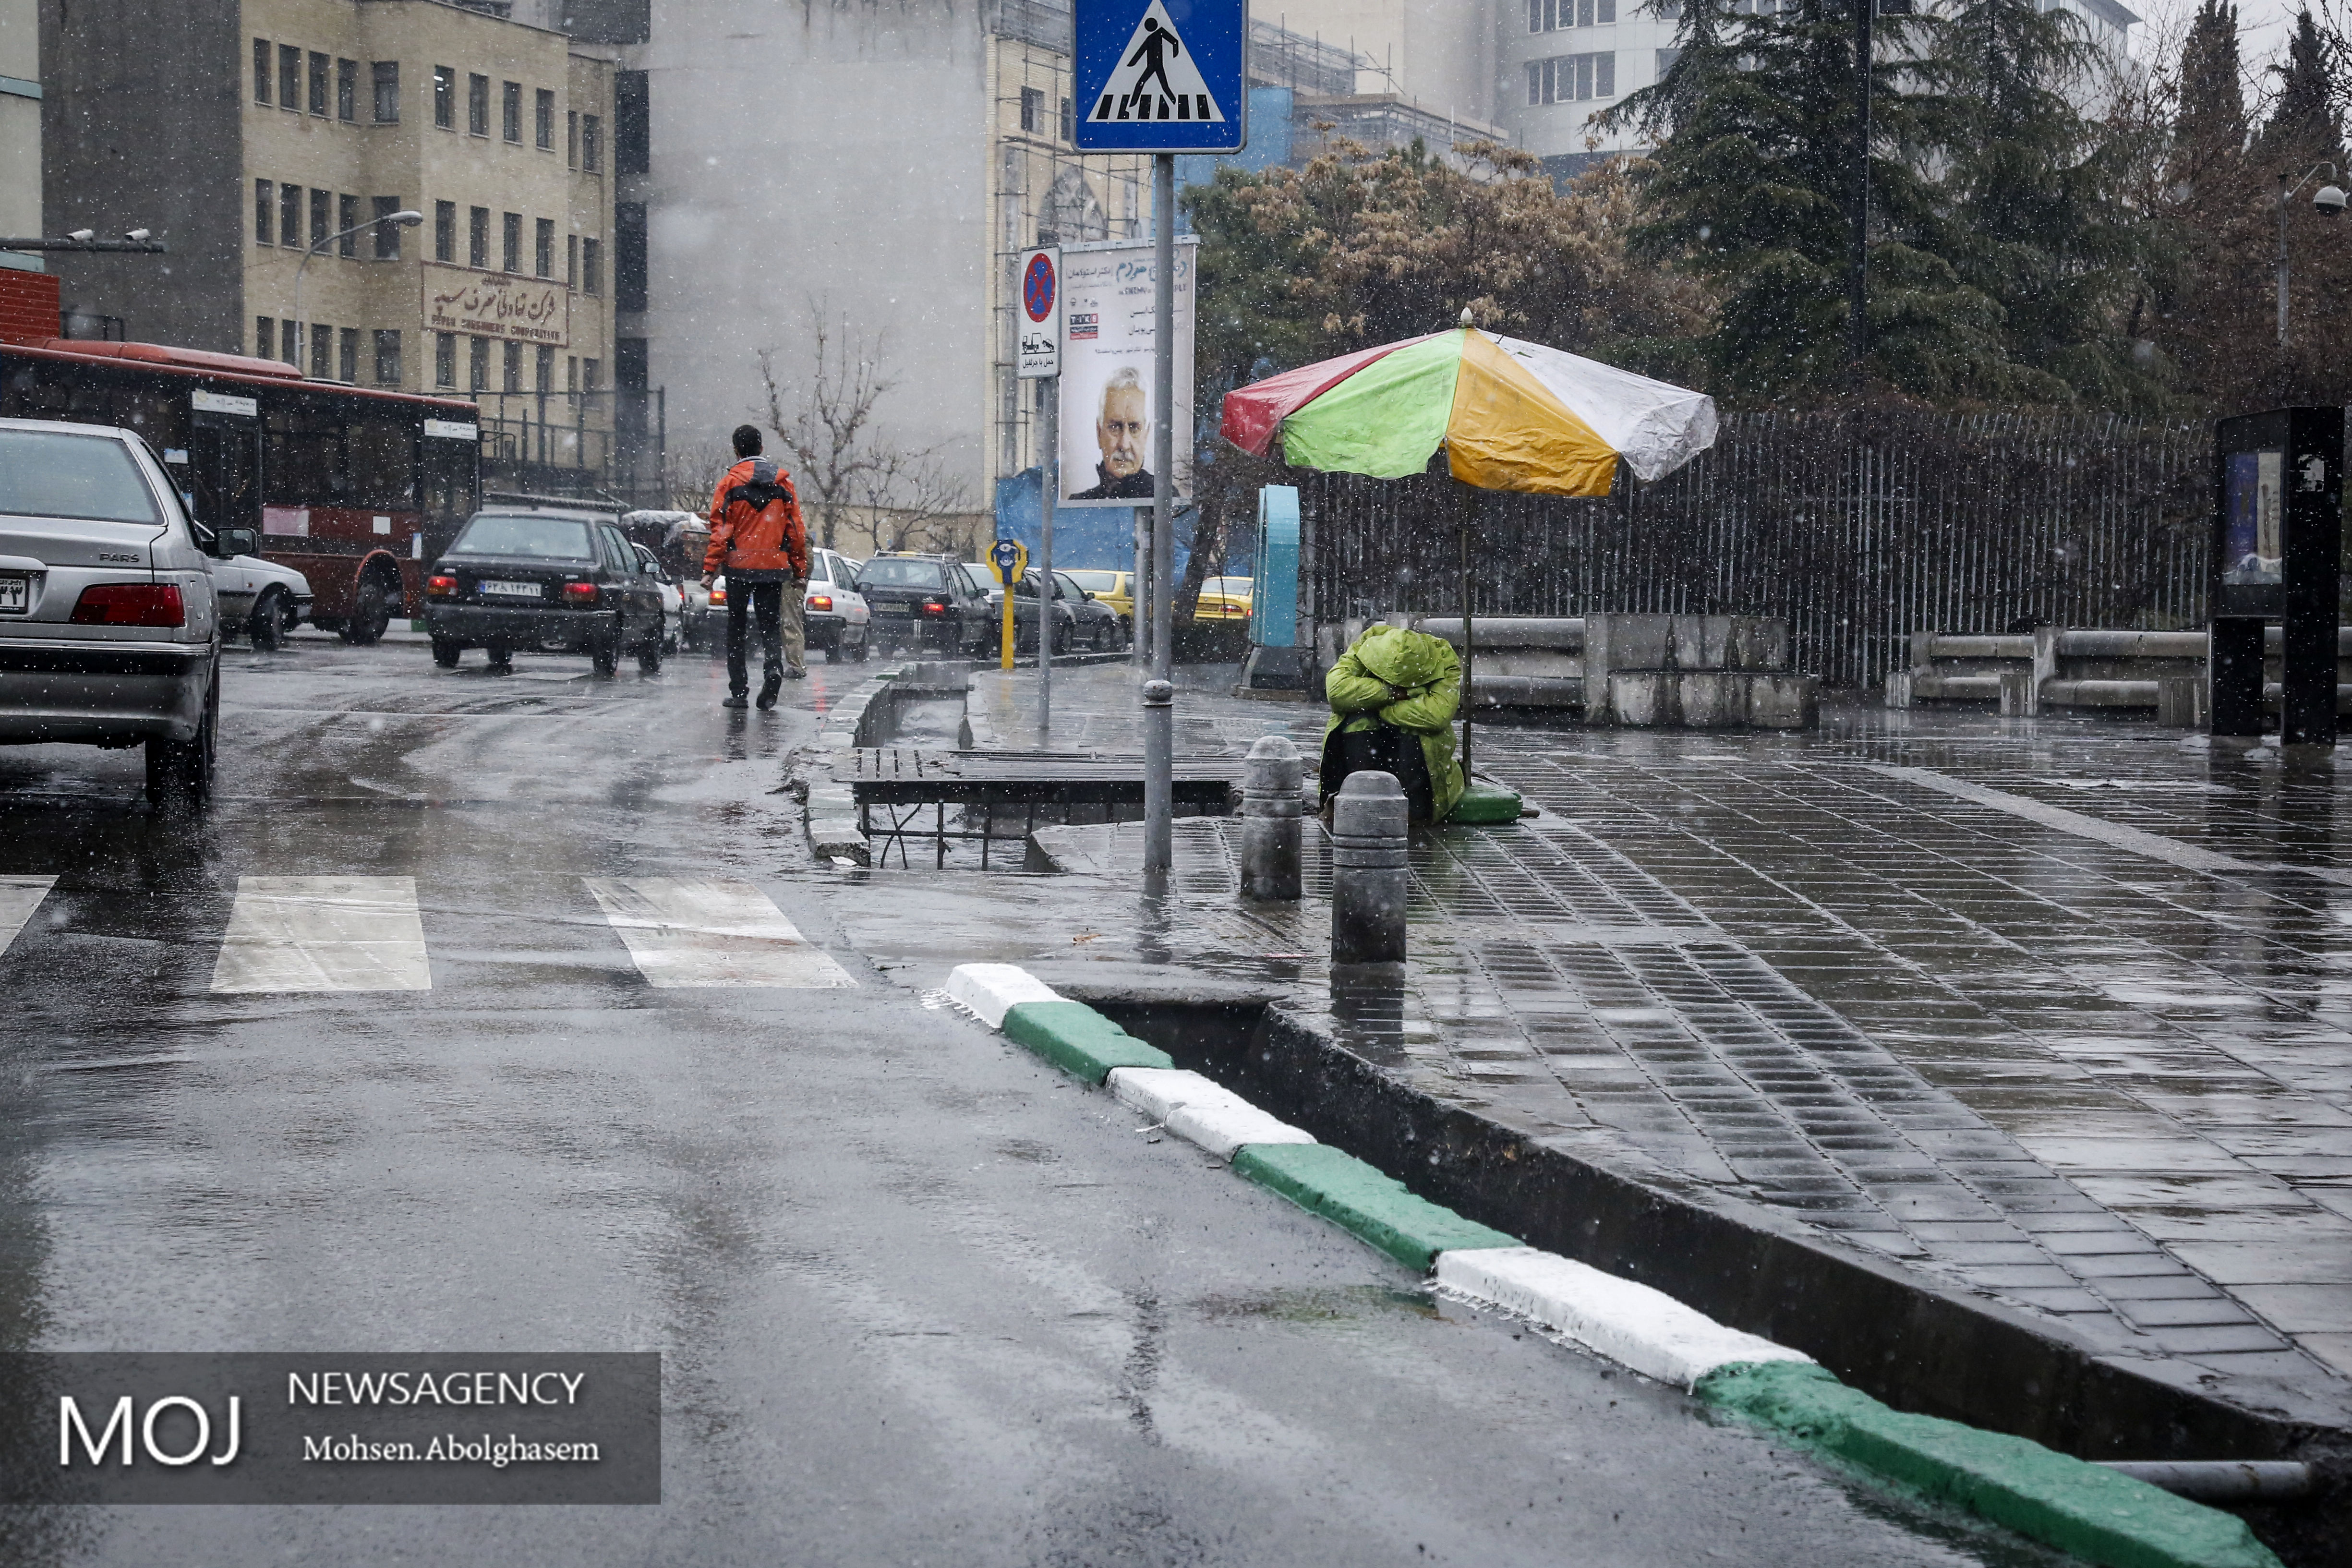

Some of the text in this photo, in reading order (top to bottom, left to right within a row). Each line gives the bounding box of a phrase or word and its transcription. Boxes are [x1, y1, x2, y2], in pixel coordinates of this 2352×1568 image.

[1022, 357, 1054, 369] حمل با جرثقیل
[99, 552, 139, 563] PARS
